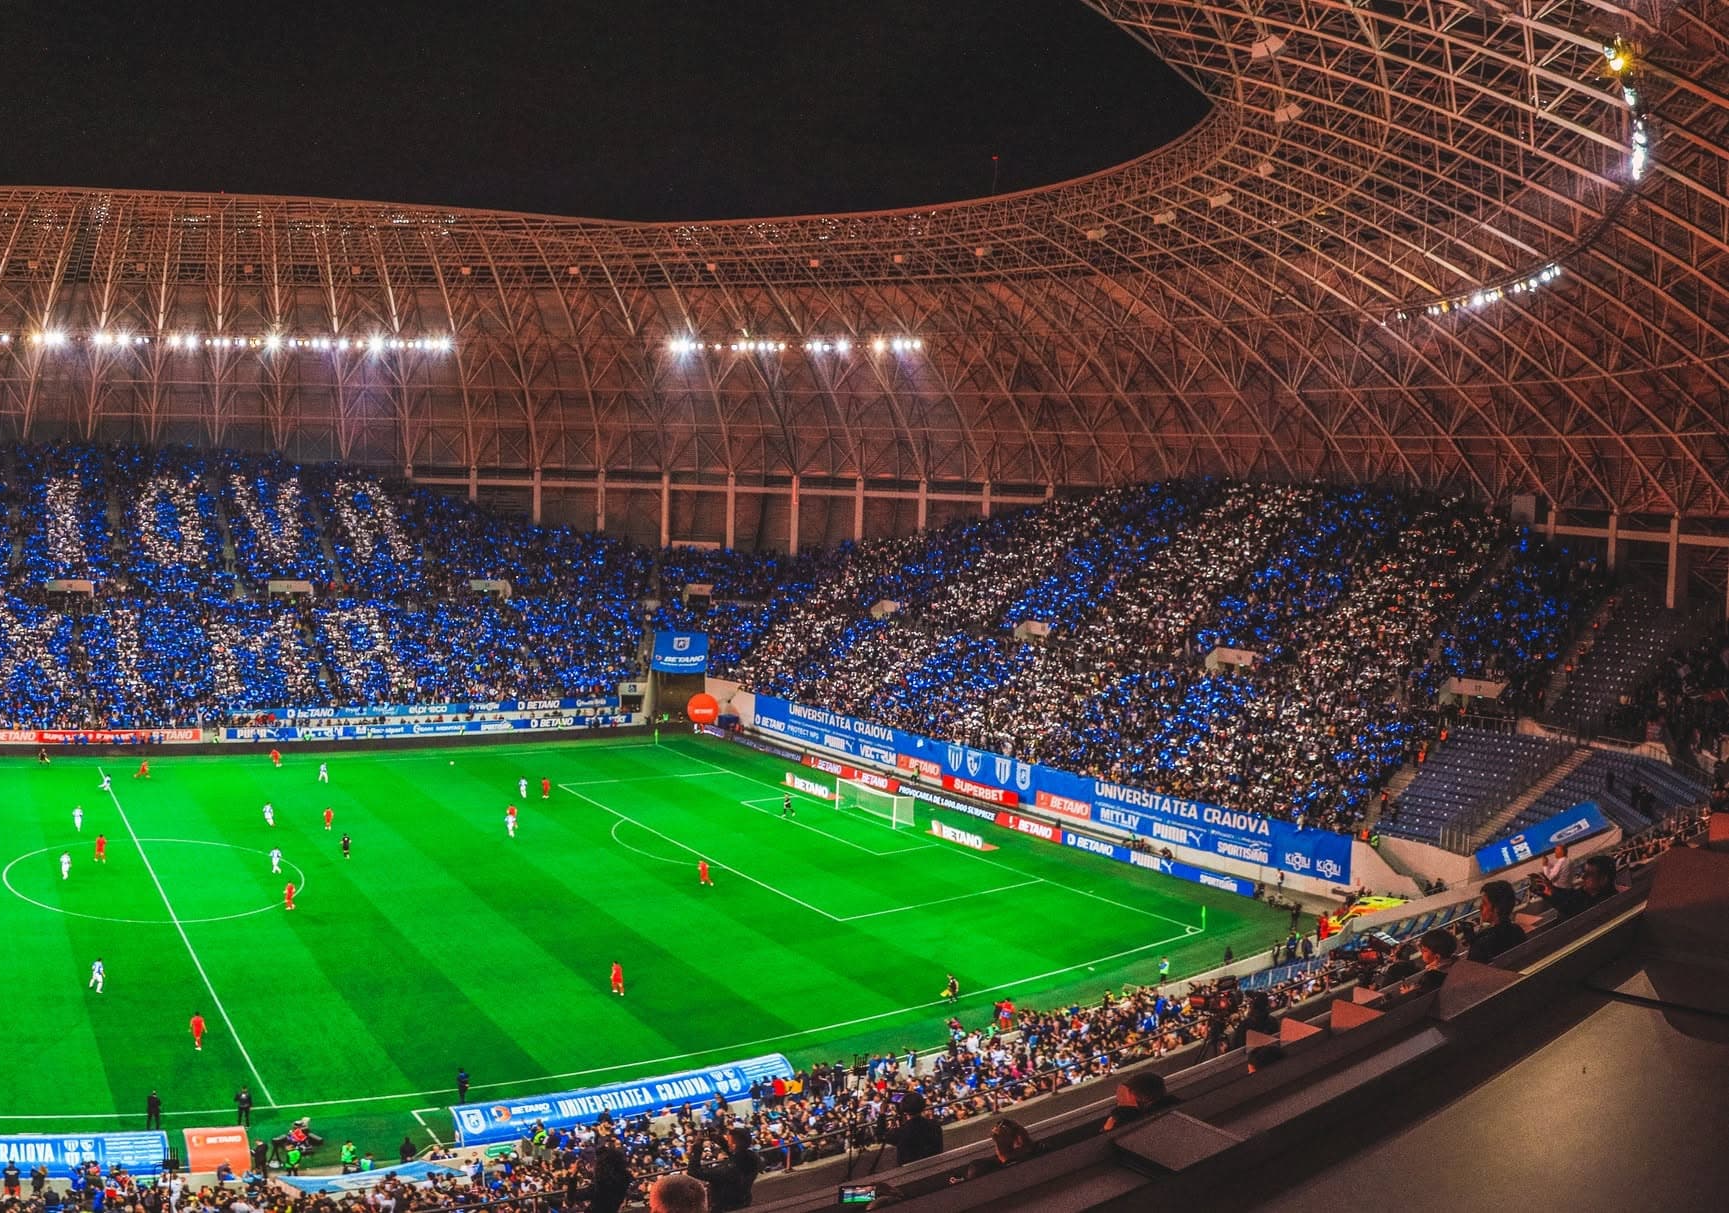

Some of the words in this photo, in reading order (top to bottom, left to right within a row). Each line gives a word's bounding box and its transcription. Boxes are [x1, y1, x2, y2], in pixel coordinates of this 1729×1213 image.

[663, 655, 705, 663] BETANO
[527, 700, 560, 710] BETANO
[540, 718, 573, 728] BETANO
[761, 716, 786, 731] BETANO
[789, 703, 851, 731] UNIVERSITATEA
[854, 721, 894, 742] CRAIOVA
[817, 760, 842, 775] BETANO
[909, 758, 940, 776] BETANO
[793, 775, 829, 799] BETANO
[862, 773, 888, 788] BETANO
[954, 778, 1005, 801] SUPERBET
[1050, 796, 1089, 816] BETANO
[1095, 781, 1198, 820] UNIVERSITATEA
[1203, 807, 1270, 836] CRAIOVA
[1100, 807, 1140, 829] MITLIV
[941, 824, 983, 849] BETANO
[1018, 820, 1053, 839] BETANO
[1153, 822, 1187, 844] PUMA
[1077, 837, 1113, 856] BETANO
[1130, 851, 1161, 871] PUMA
[557, 1087, 654, 1118] UNIVERSITATEA
[656, 1076, 711, 1101] CRAIOVA
[511, 1103, 550, 1115] BETANO
